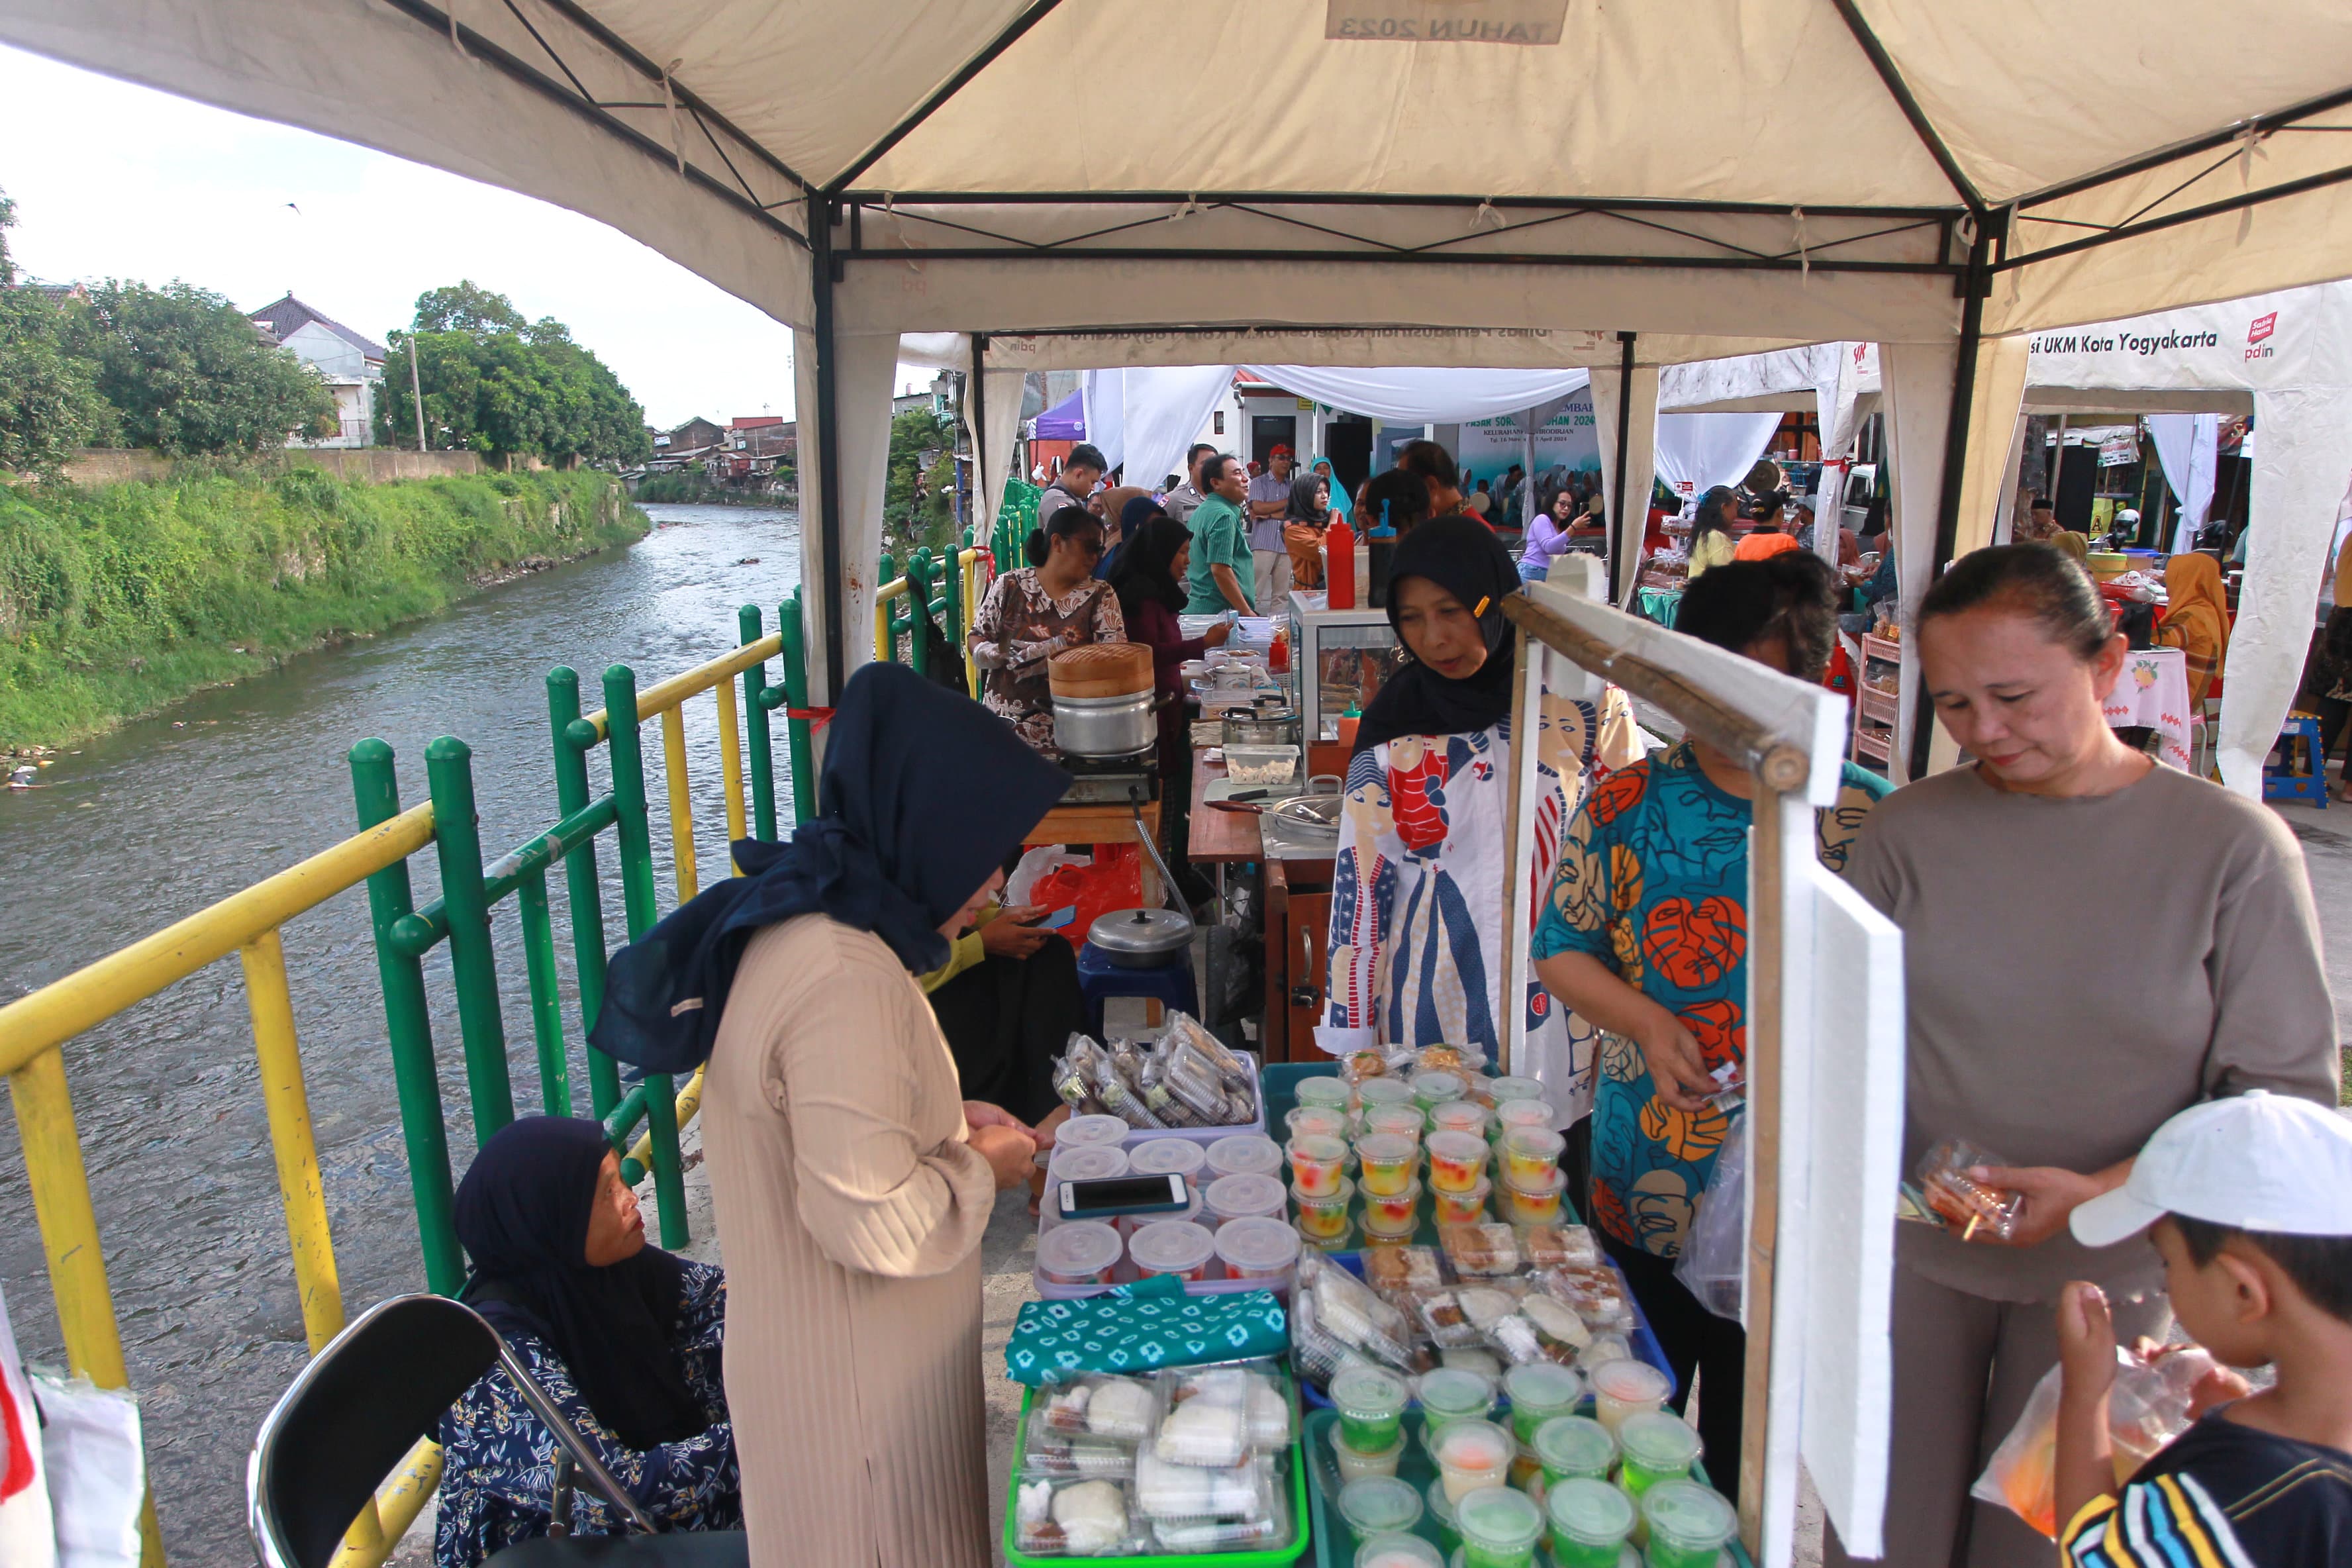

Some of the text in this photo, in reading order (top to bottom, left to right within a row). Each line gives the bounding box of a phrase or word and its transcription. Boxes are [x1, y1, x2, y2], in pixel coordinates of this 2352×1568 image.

[2044, 336, 2076, 354] UKM
[2081, 335, 2114, 352] Kota
[2119, 329, 2218, 356] Yogyakarta
[2245, 344, 2273, 363] pdin
